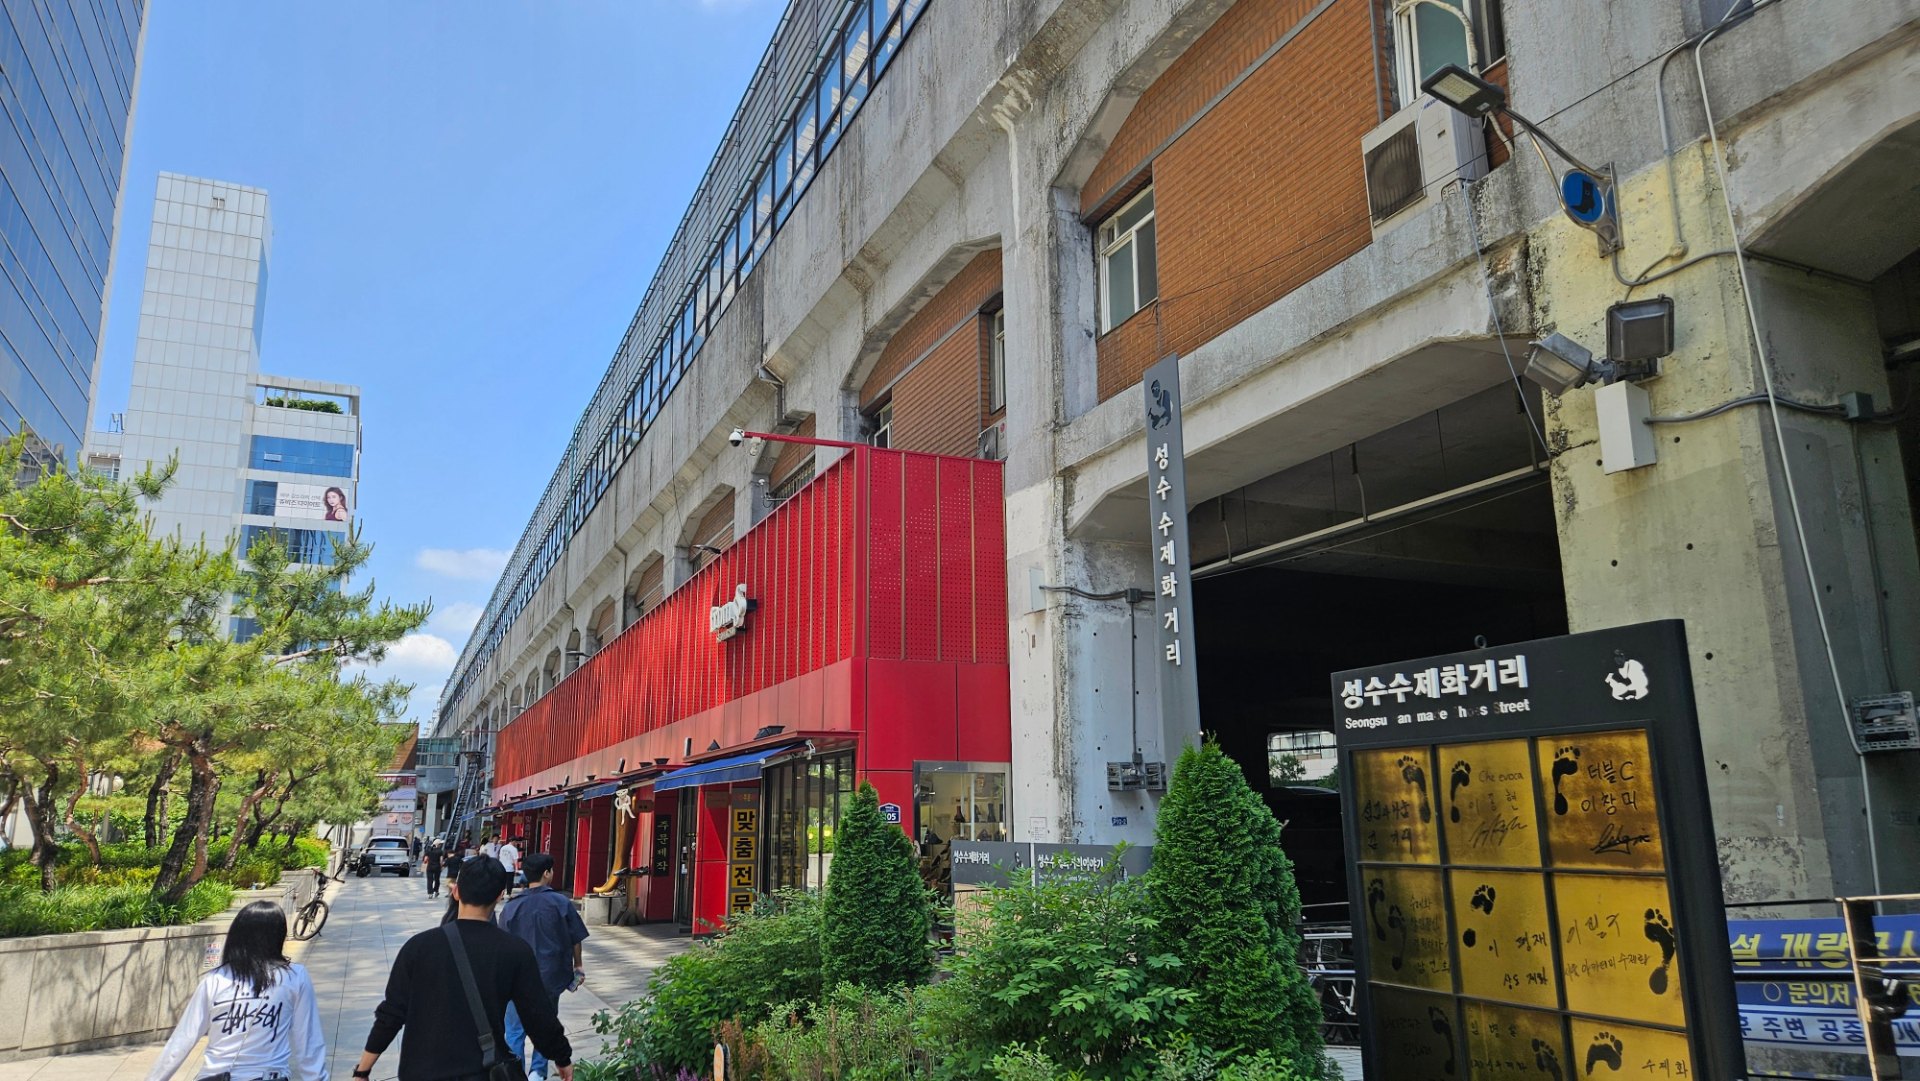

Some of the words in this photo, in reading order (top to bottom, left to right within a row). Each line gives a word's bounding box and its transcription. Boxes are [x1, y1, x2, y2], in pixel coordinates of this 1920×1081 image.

[1340, 655, 1529, 710] 성수수제화거리
[1345, 716, 1388, 730] Seongsu
[1762, 1016, 1808, 1041] 주변
[1642, 1058, 1689, 1079] 수제화
